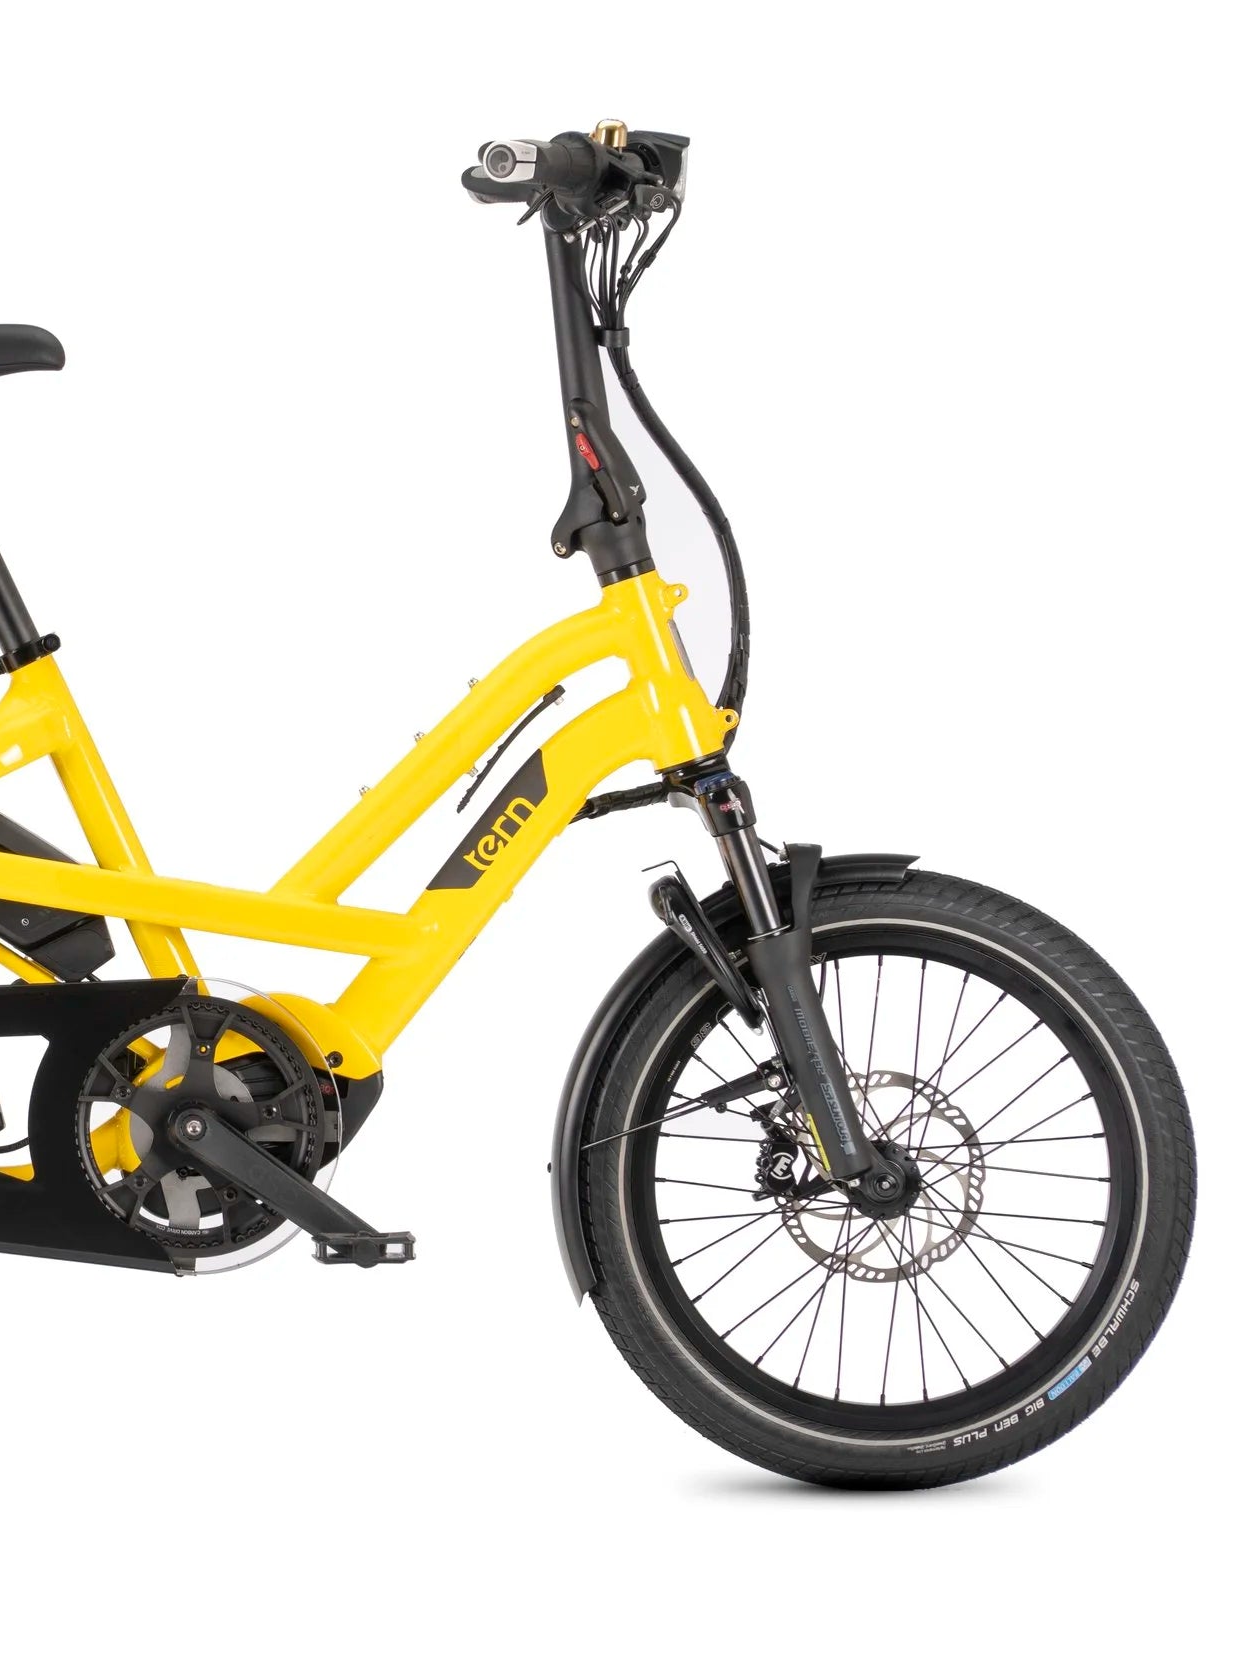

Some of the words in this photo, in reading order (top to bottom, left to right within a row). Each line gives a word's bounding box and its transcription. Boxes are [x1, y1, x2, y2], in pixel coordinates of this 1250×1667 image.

[1091, 1278, 1140, 1358] SCHWALBE
[1025, 1398, 1045, 1416] BIG
[995, 1413, 1019, 1432] BEN
[953, 1428, 988, 1447] PLUS
